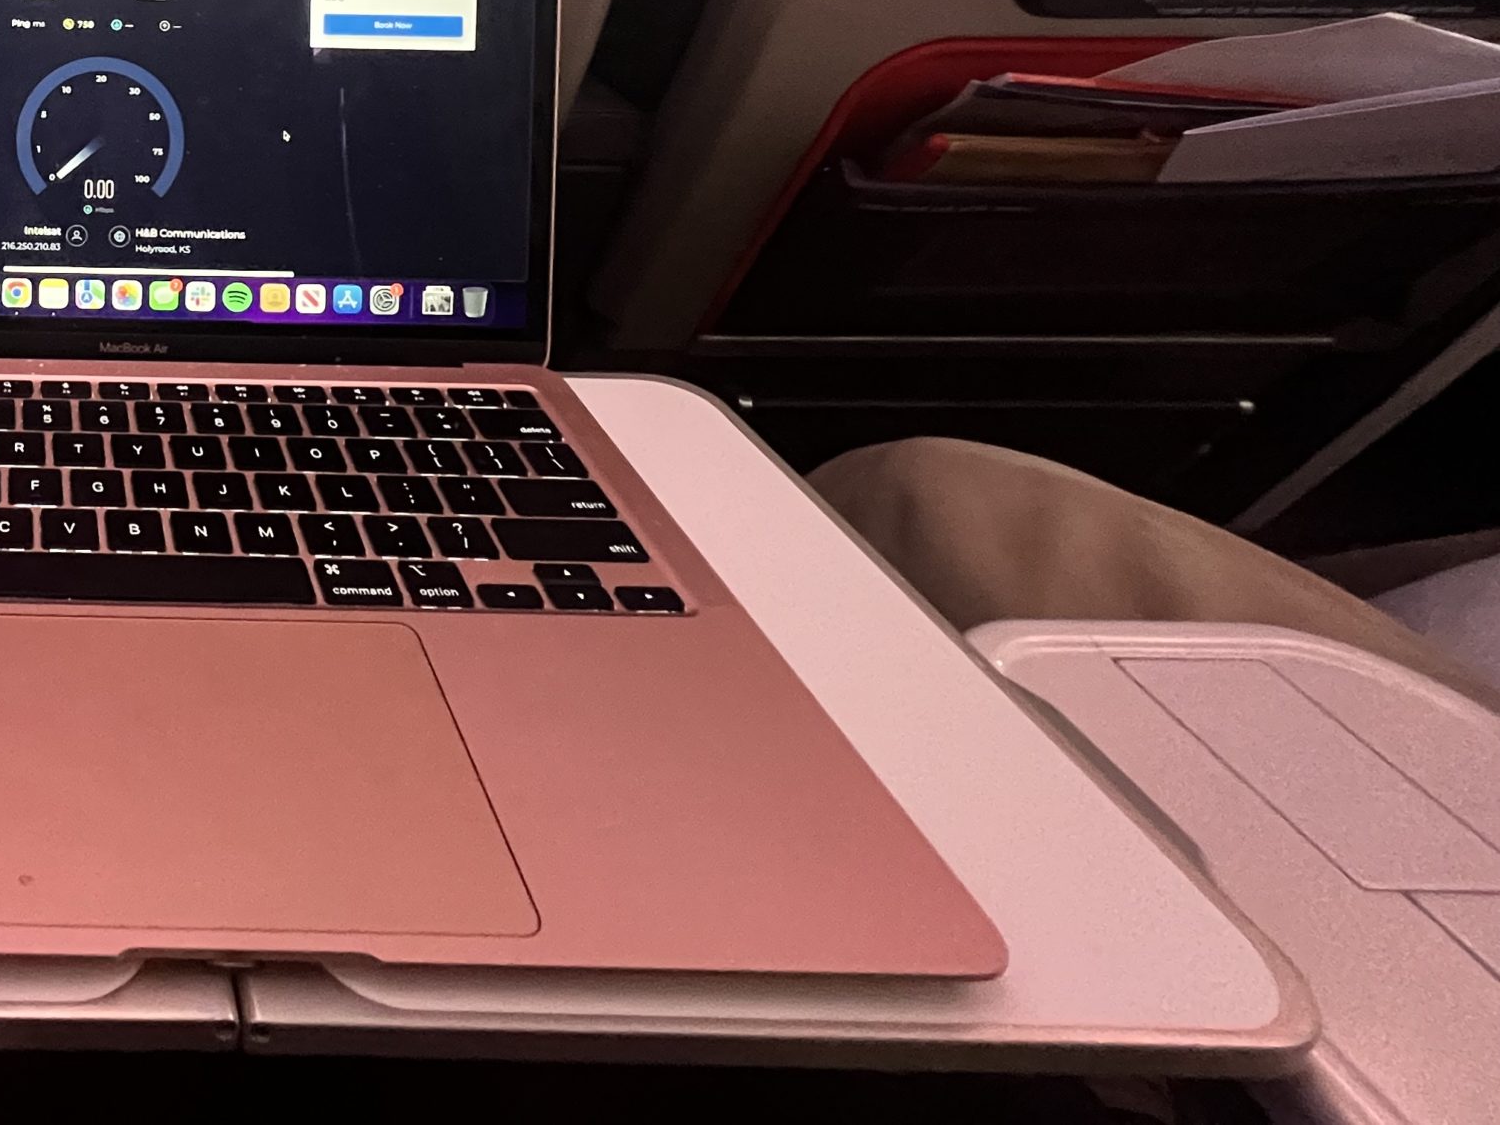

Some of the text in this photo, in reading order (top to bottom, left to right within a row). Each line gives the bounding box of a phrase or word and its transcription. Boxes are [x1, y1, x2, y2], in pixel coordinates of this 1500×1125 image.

[11, 19, 31, 29] Ping
[374, 21, 394, 29] Book
[95, 75, 107, 83] 20
[61, 86, 72, 94] 10
[129, 87, 141, 96] 30
[41, 110, 47, 119] 5
[149, 113, 161, 121] 50
[152, 148, 164, 156] 75
[135, 175, 150, 183] 100
[84, 179, 115, 199] 0.00
[24, 226, 62, 237] Intelsat
[135, 228, 246, 240] H&B Communications
[179, 245, 191, 254] KS
[100, 342, 169, 354] MacBook Air
[43, 414, 52, 424] 5
[100, 415, 110, 425] 6
[156, 416, 165, 425] 7
[214, 418, 225, 427] 8
[271, 418, 282, 428] 9
[14, 442, 25, 453] R
[73, 443, 84, 454] T
[132, 445, 143, 455] Y
[191, 446, 204, 457] U
[254, 448, 260, 458] I
[309, 448, 322, 459] O
[369, 449, 381, 460] P
[31, 479, 40, 491] F
[92, 481, 105, 493] G
[154, 483, 167, 494] H
[219, 484, 228, 496] J
[278, 485, 291, 497] K
[341, 486, 353, 498] L
[571, 501, 606, 510] return
[63, 522, 76, 535] V
[129, 523, 141, 536] B
[194, 525, 209, 537] N
[258, 526, 275, 539] M
[609, 544, 638, 554] shift
[332, 585, 393, 597] command
[419, 587, 460, 598] option
